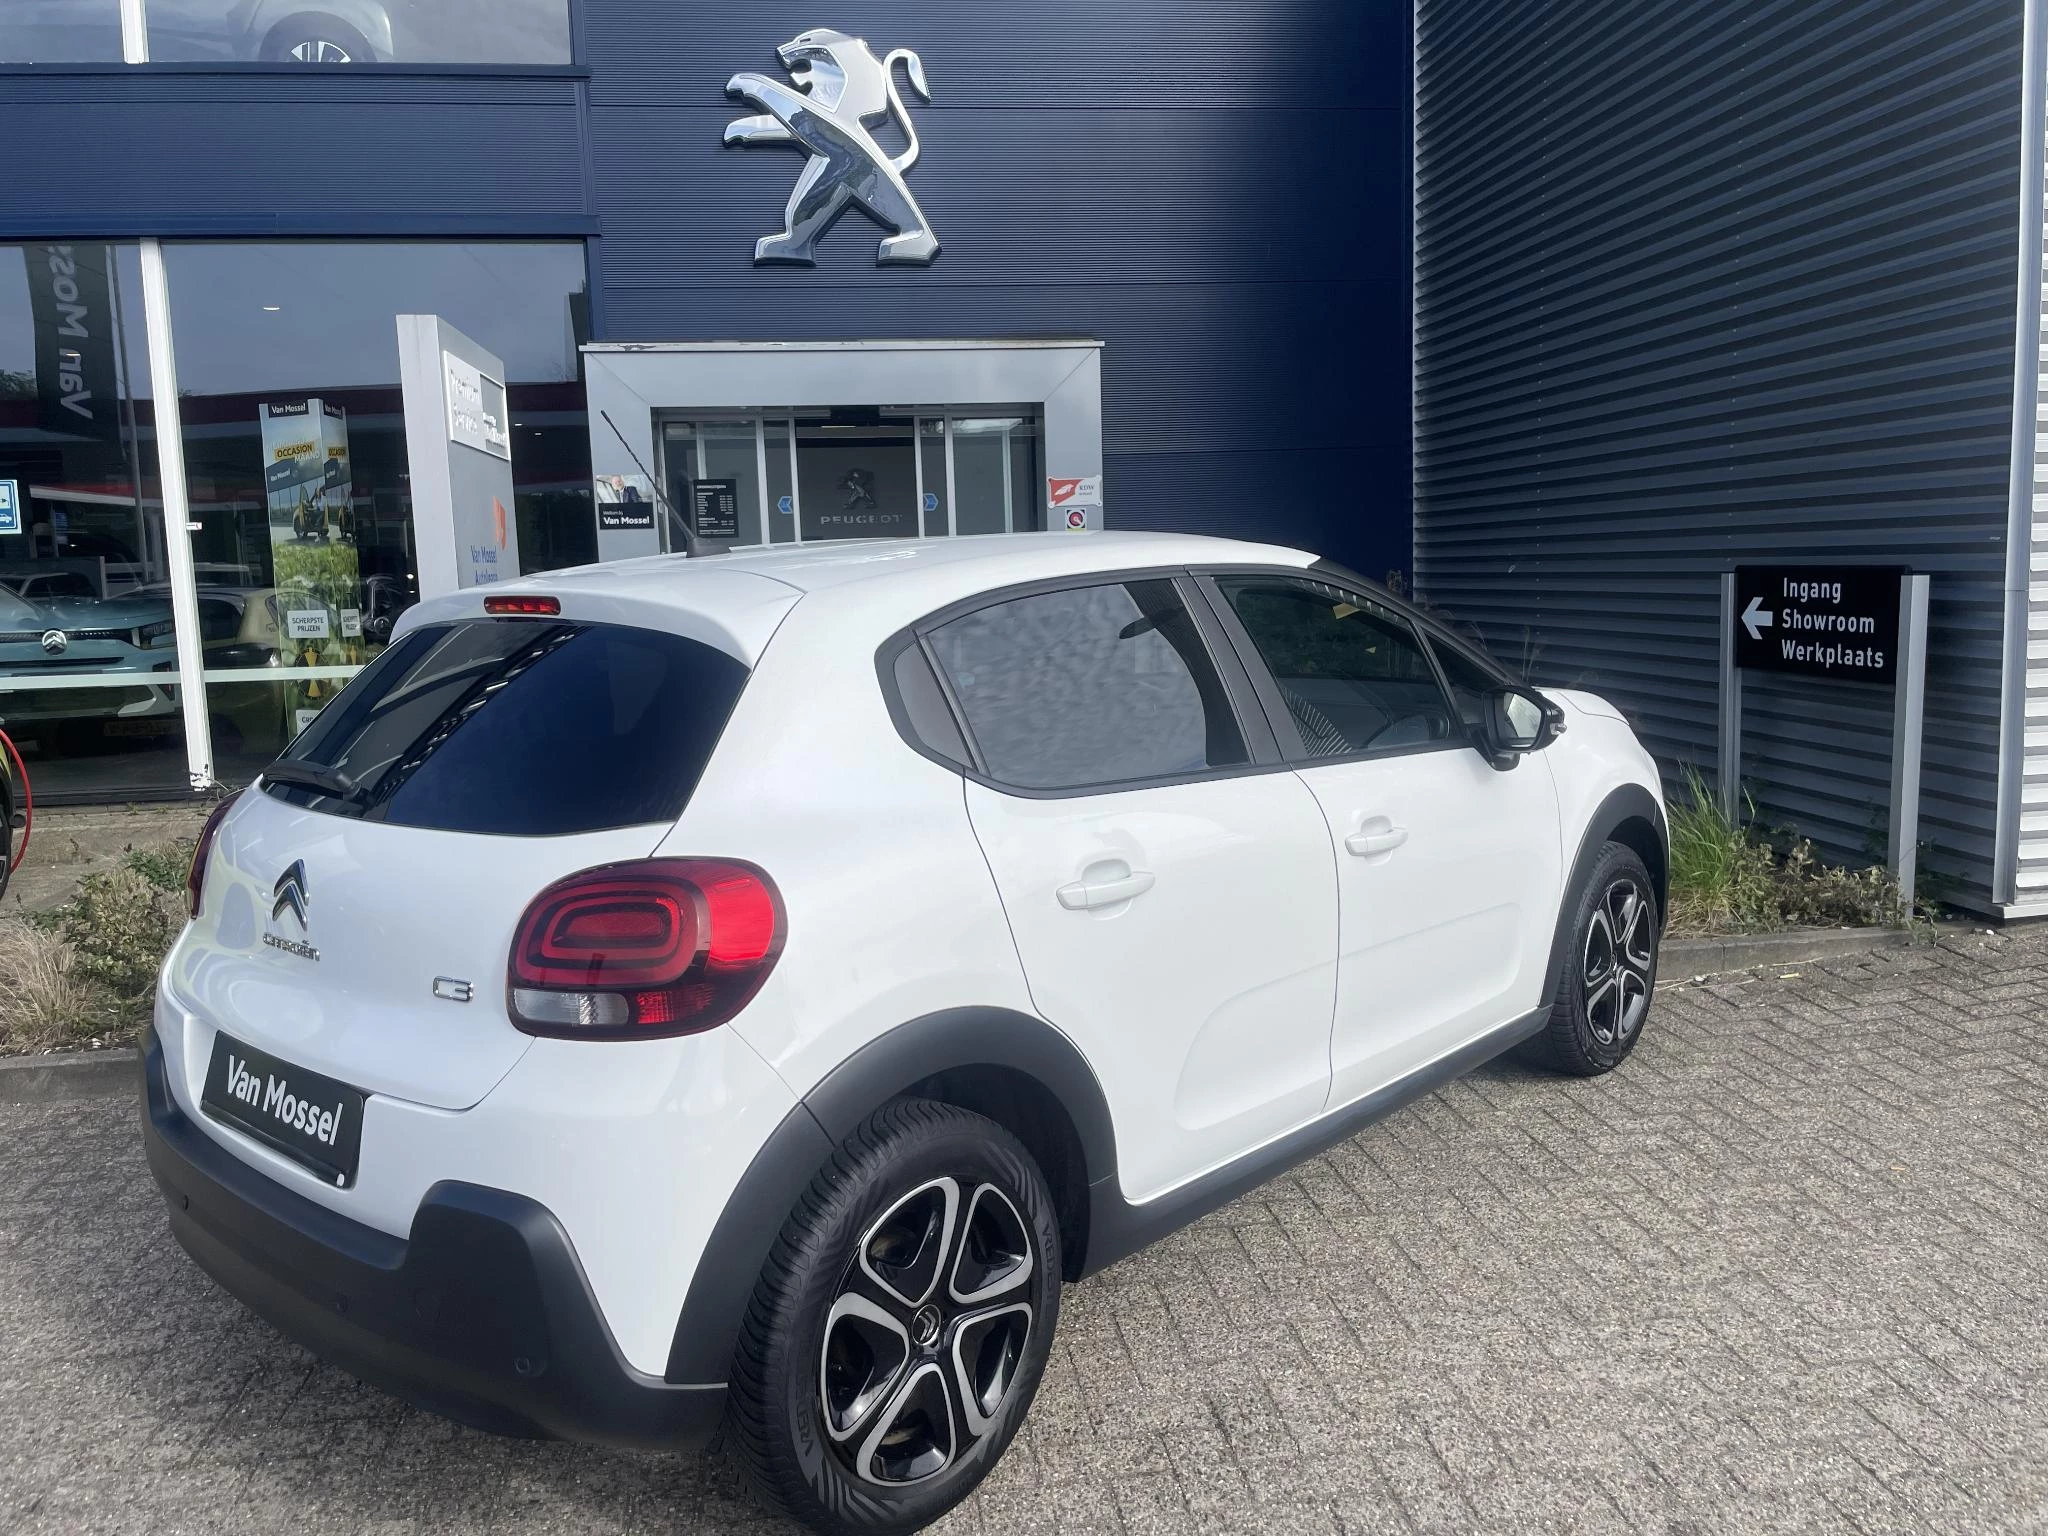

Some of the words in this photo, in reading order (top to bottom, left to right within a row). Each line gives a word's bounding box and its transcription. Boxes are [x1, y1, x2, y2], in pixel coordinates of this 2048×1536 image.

[271, 406, 284, 414] Van
[285, 403, 306, 413] Mossel
[276, 444, 313, 458] OCCASION
[603, 517, 620, 525] Van
[621, 516, 650, 525] Mossel
[820, 514, 902, 525] PEUGEOT
[470, 545, 480, 563] Van
[1783, 577, 1842, 604] Ingang
[297, 624, 321, 632] PRIJZEN
[1782, 608, 1875, 633] Showroom
[1781, 639, 1884, 669] Werkplaats
[433, 976, 473, 1002] C3
[227, 1054, 261, 1107] Van
[262, 1074, 343, 1146] Mossel
